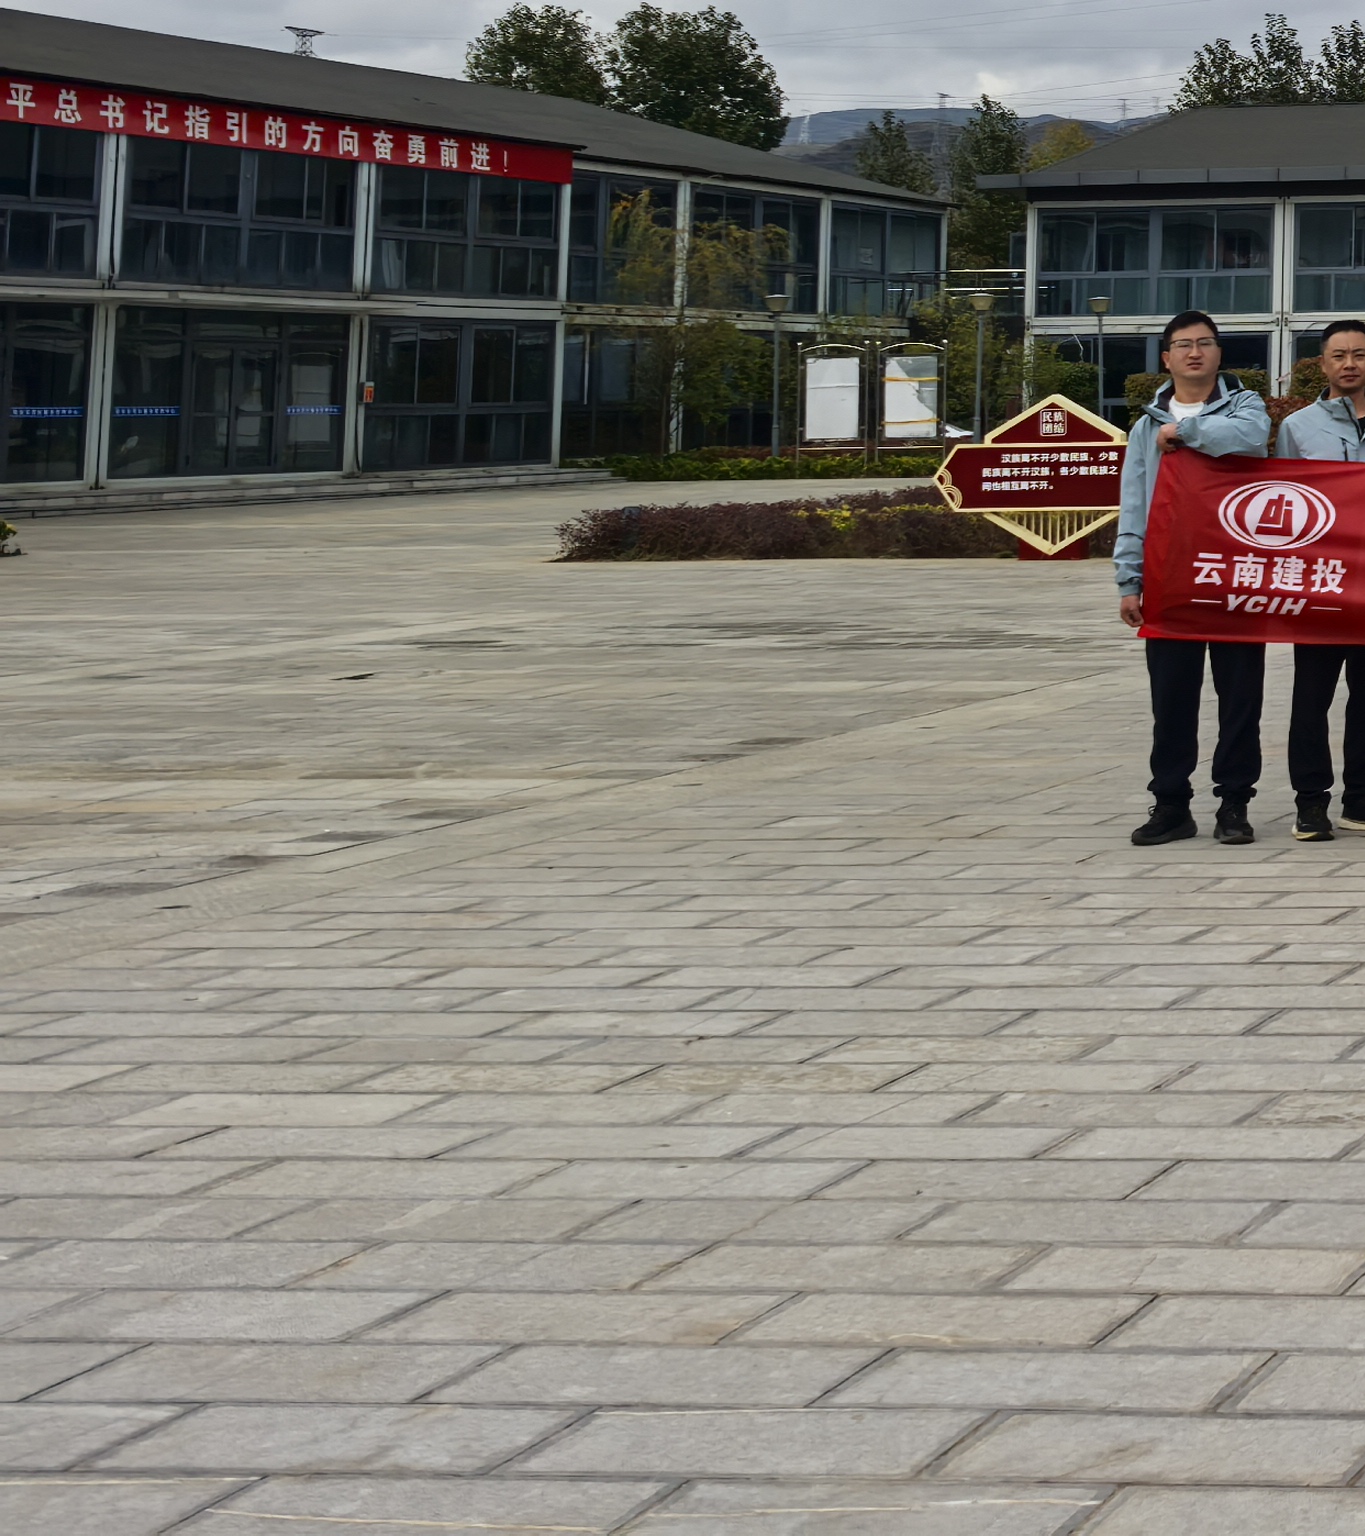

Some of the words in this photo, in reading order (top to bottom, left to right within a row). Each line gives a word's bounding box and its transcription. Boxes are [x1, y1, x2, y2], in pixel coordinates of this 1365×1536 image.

[6, 82, 508, 173] 平总书记指引的方向奋勇前进！
[1042, 411, 1065, 423] 民族
[1042, 423, 1065, 434] 团结
[1193, 552, 1347, 594] 云南建投
[1226, 594, 1308, 616] YCIH
